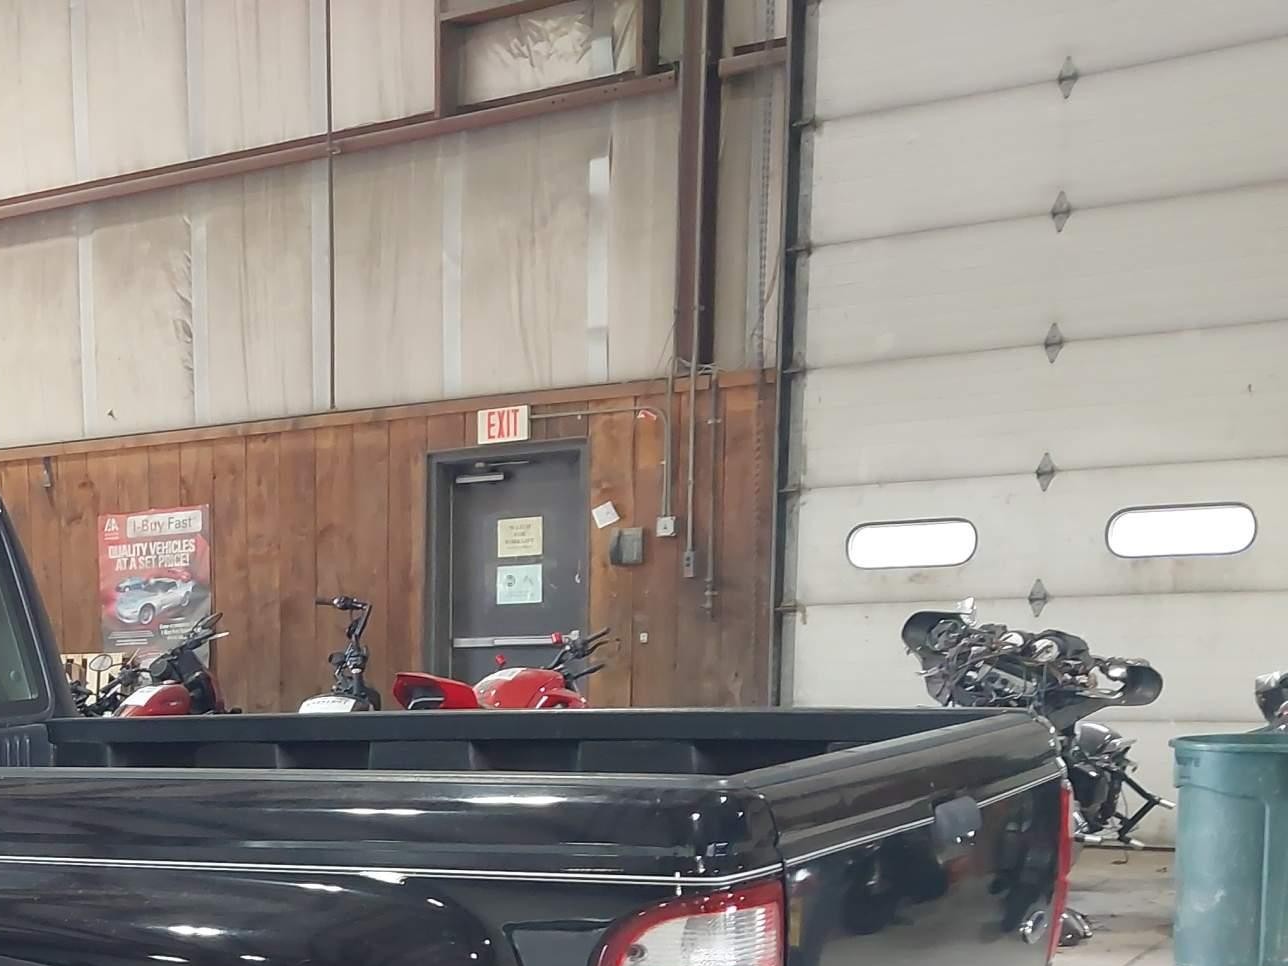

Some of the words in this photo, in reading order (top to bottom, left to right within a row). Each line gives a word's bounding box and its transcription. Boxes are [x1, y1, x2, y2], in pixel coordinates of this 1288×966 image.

[488, 409, 520, 440] EXIT
[133, 520, 163, 534] I-Buy
[168, 516, 193, 529] Fast
[108, 543, 148, 559] QUALITY
[149, 539, 196, 556] VEHICLES
[115, 558, 128, 571] AT
[129, 557, 137, 570] A
[138, 555, 157, 569] SET
